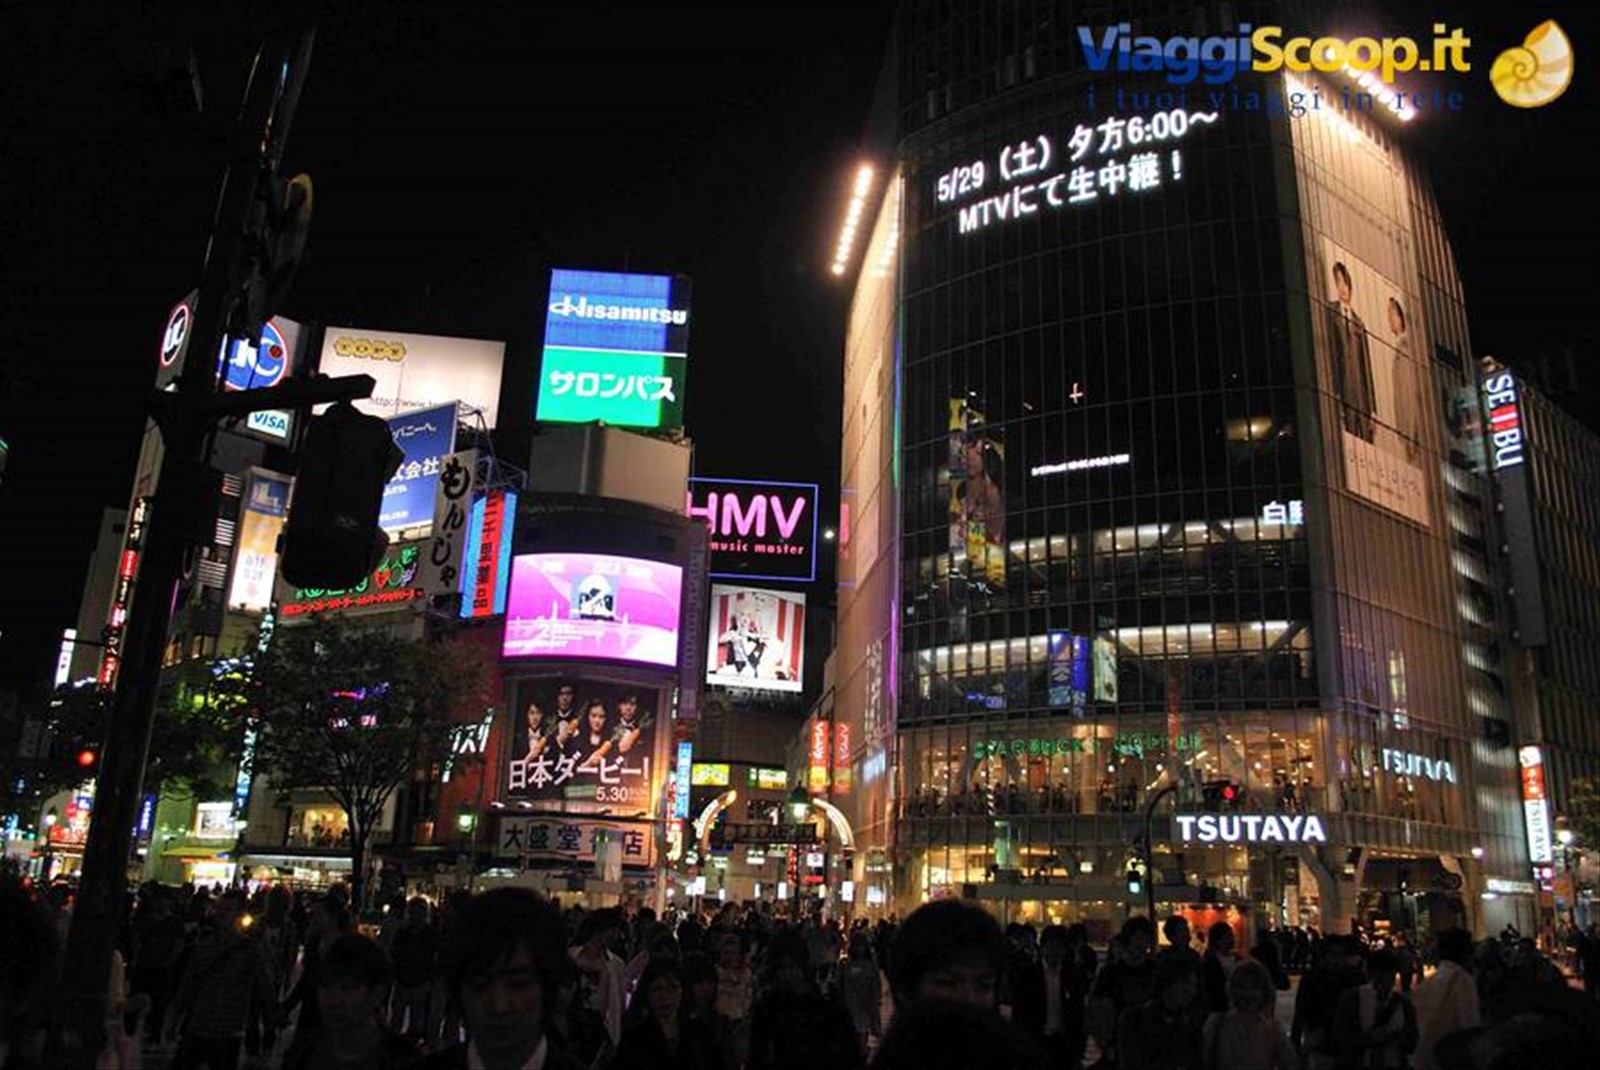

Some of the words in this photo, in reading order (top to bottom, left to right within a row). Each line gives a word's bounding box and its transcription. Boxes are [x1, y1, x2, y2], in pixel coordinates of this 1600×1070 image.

[937, 161, 985, 201] 5/29
[549, 295, 688, 325] Hisamitsu
[549, 370, 676, 402] サロンパス
[253, 412, 287, 431] VISA
[431, 457, 471, 587] もんじゃ
[687, 490, 806, 539] HMV
[754, 542, 804, 556] master
[596, 786, 628, 802] 5.30
[504, 823, 644, 857] 大盛堂店
[1176, 815, 1327, 842] TSUTAYA
